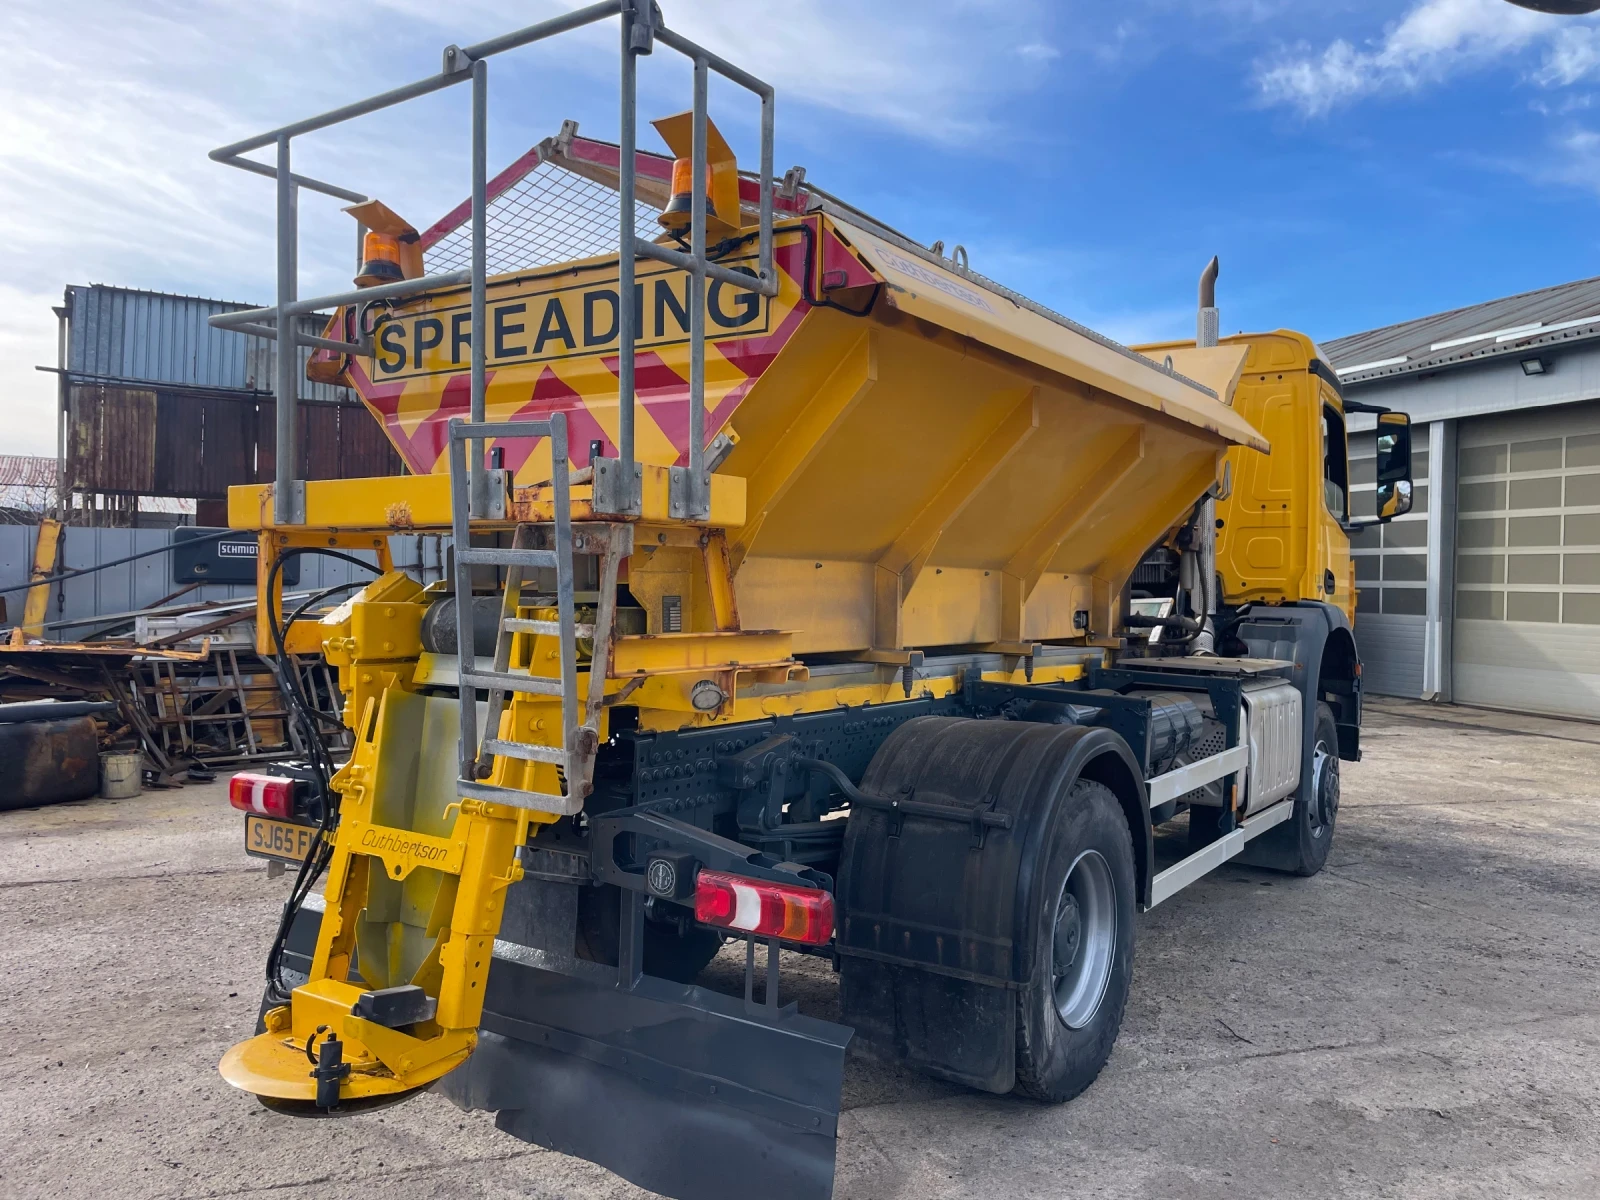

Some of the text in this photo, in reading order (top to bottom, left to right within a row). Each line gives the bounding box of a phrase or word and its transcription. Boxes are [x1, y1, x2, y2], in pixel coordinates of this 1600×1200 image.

[378, 266, 760, 374] SPREADING
[254, 822, 294, 854] SJ65
[361, 829, 448, 861] Cuthbertson
